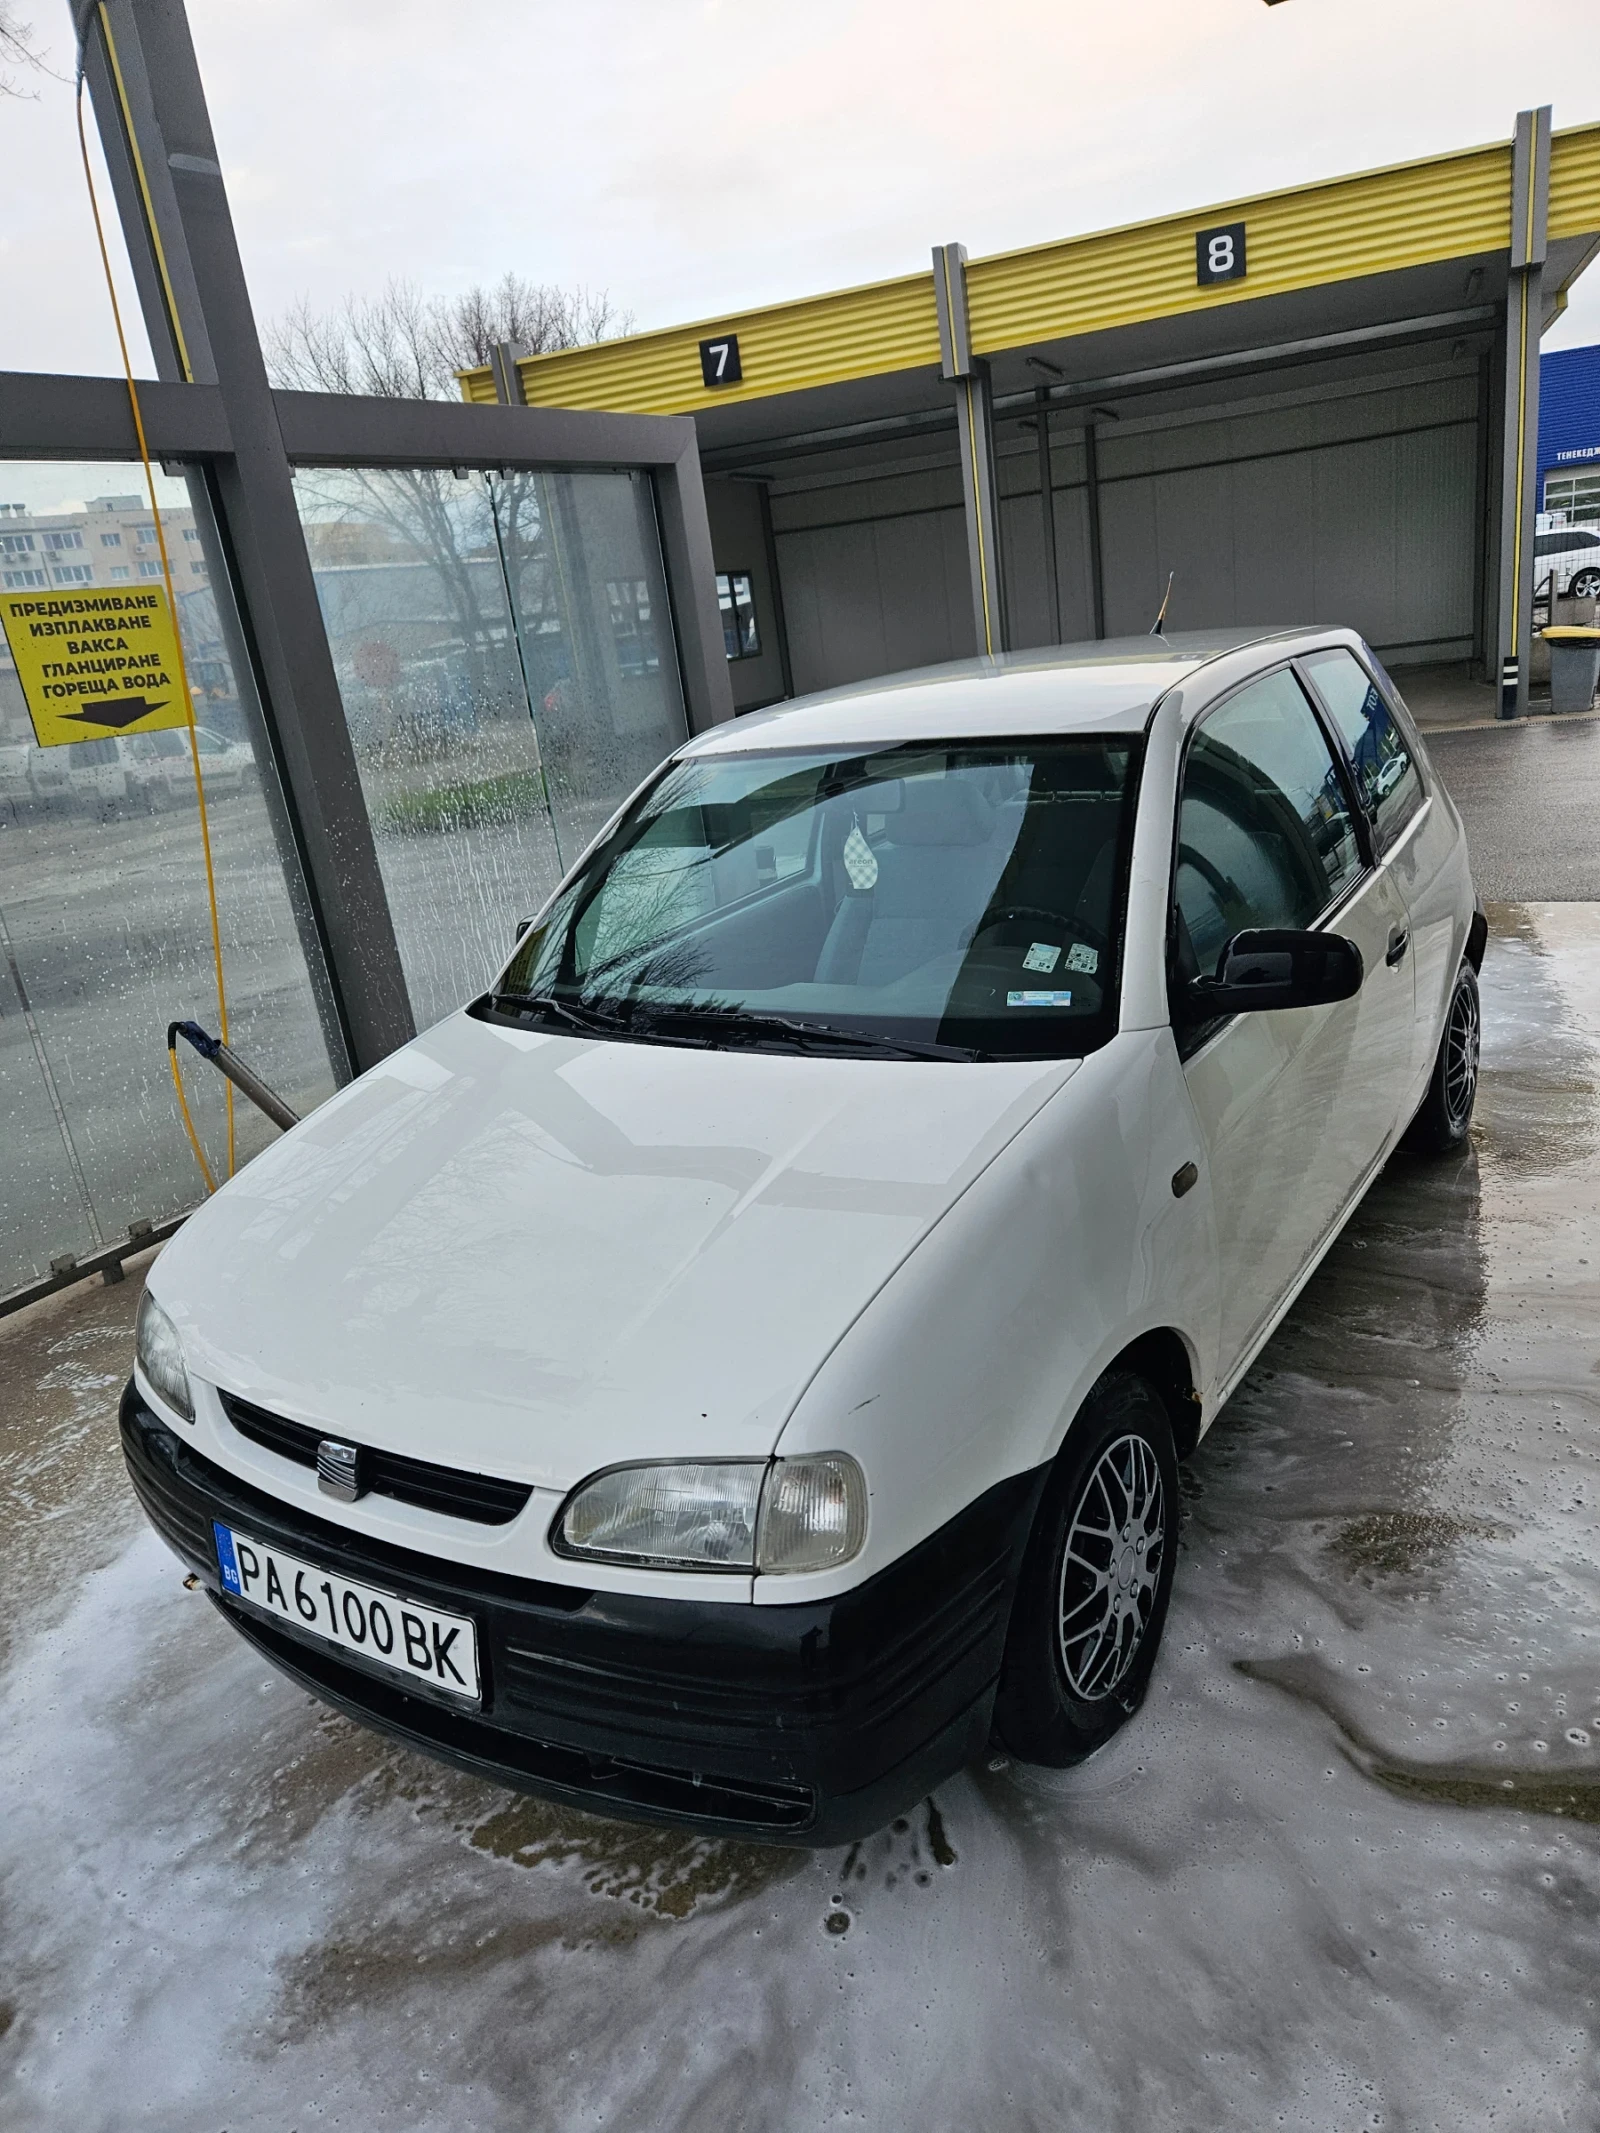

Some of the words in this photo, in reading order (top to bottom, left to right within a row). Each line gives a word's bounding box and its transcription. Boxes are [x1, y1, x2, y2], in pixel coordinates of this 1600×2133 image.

[1208, 234, 1235, 273] 8
[708, 343, 729, 377] 7
[9, 595, 158, 617] ПРЕДИЗМИВАНЕ
[29, 615, 152, 637] ИЗПЛАКВАНЕ
[66, 637, 129, 655] ВАКСА
[41, 654, 161, 678] ГЛАНЦИРАНЕ
[42, 678, 120, 699] ГОРЕЩА
[121, 672, 171, 690] ВОДА
[223, 1564, 239, 1585] BG
